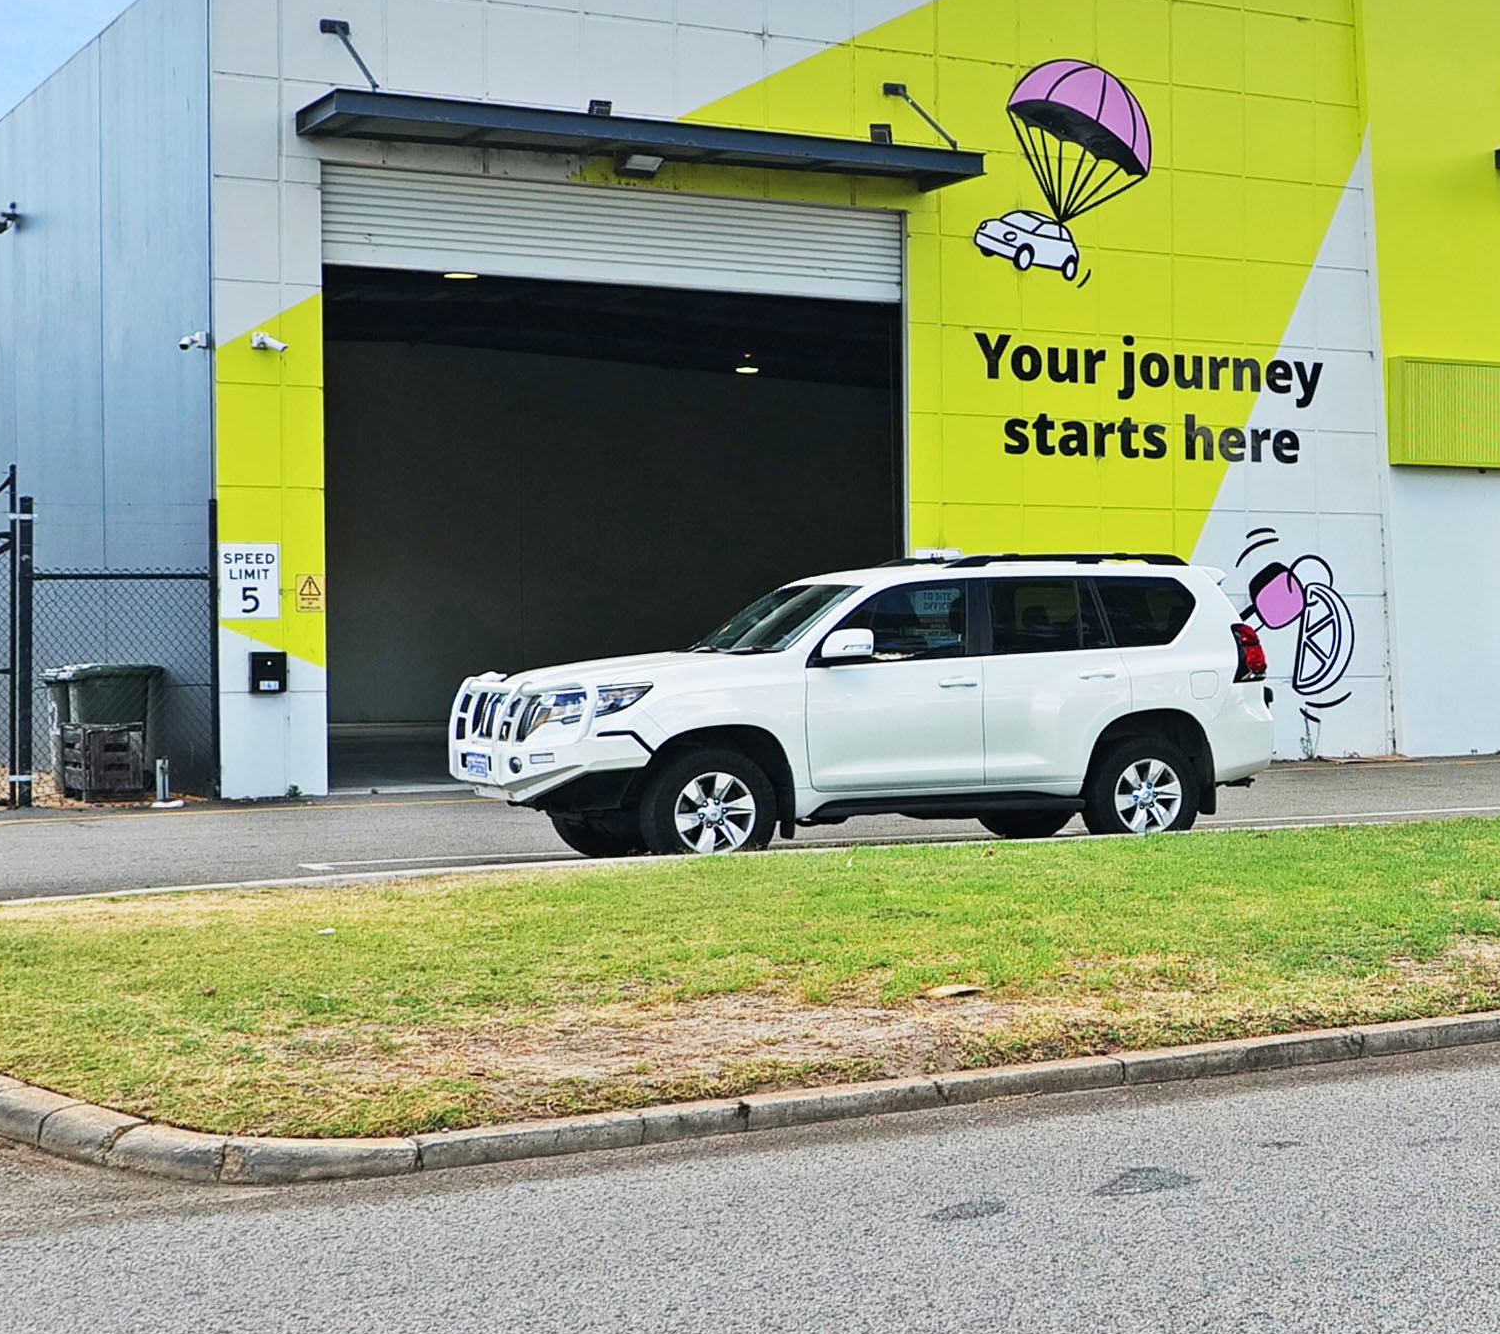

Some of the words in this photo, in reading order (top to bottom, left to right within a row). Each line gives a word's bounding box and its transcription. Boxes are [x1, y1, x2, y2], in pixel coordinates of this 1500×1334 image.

[973, 332, 1106, 384] Your
[1118, 335, 1324, 409] journey
[1004, 413, 1167, 460] starts
[1184, 413, 1300, 464] here
[223, 553, 275, 564] SPEED
[229, 569, 270, 580] LIMIT
[241, 586, 260, 614] 5
